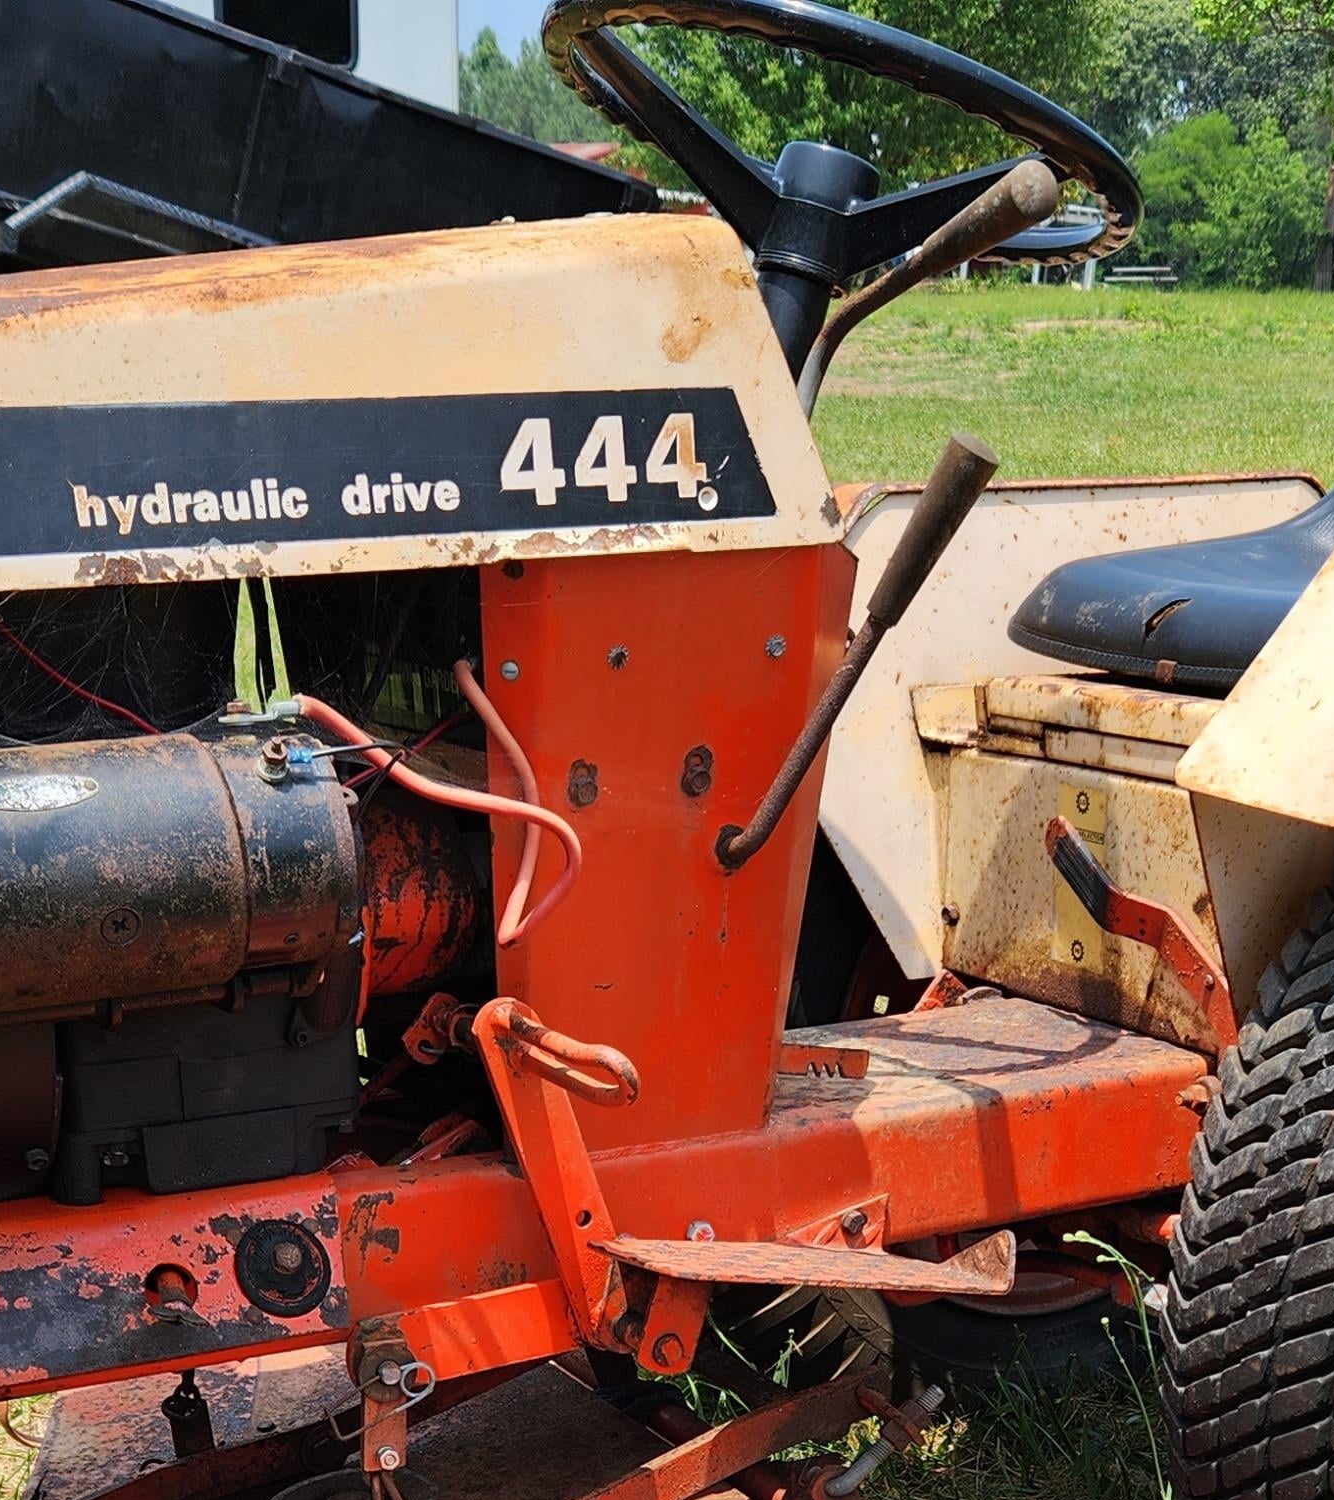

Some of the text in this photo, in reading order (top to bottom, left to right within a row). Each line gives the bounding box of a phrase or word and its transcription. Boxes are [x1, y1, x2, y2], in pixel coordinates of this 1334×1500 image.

[72, 412, 708, 535] hydraulic drive 444
[423, 664, 460, 696] GARDE
